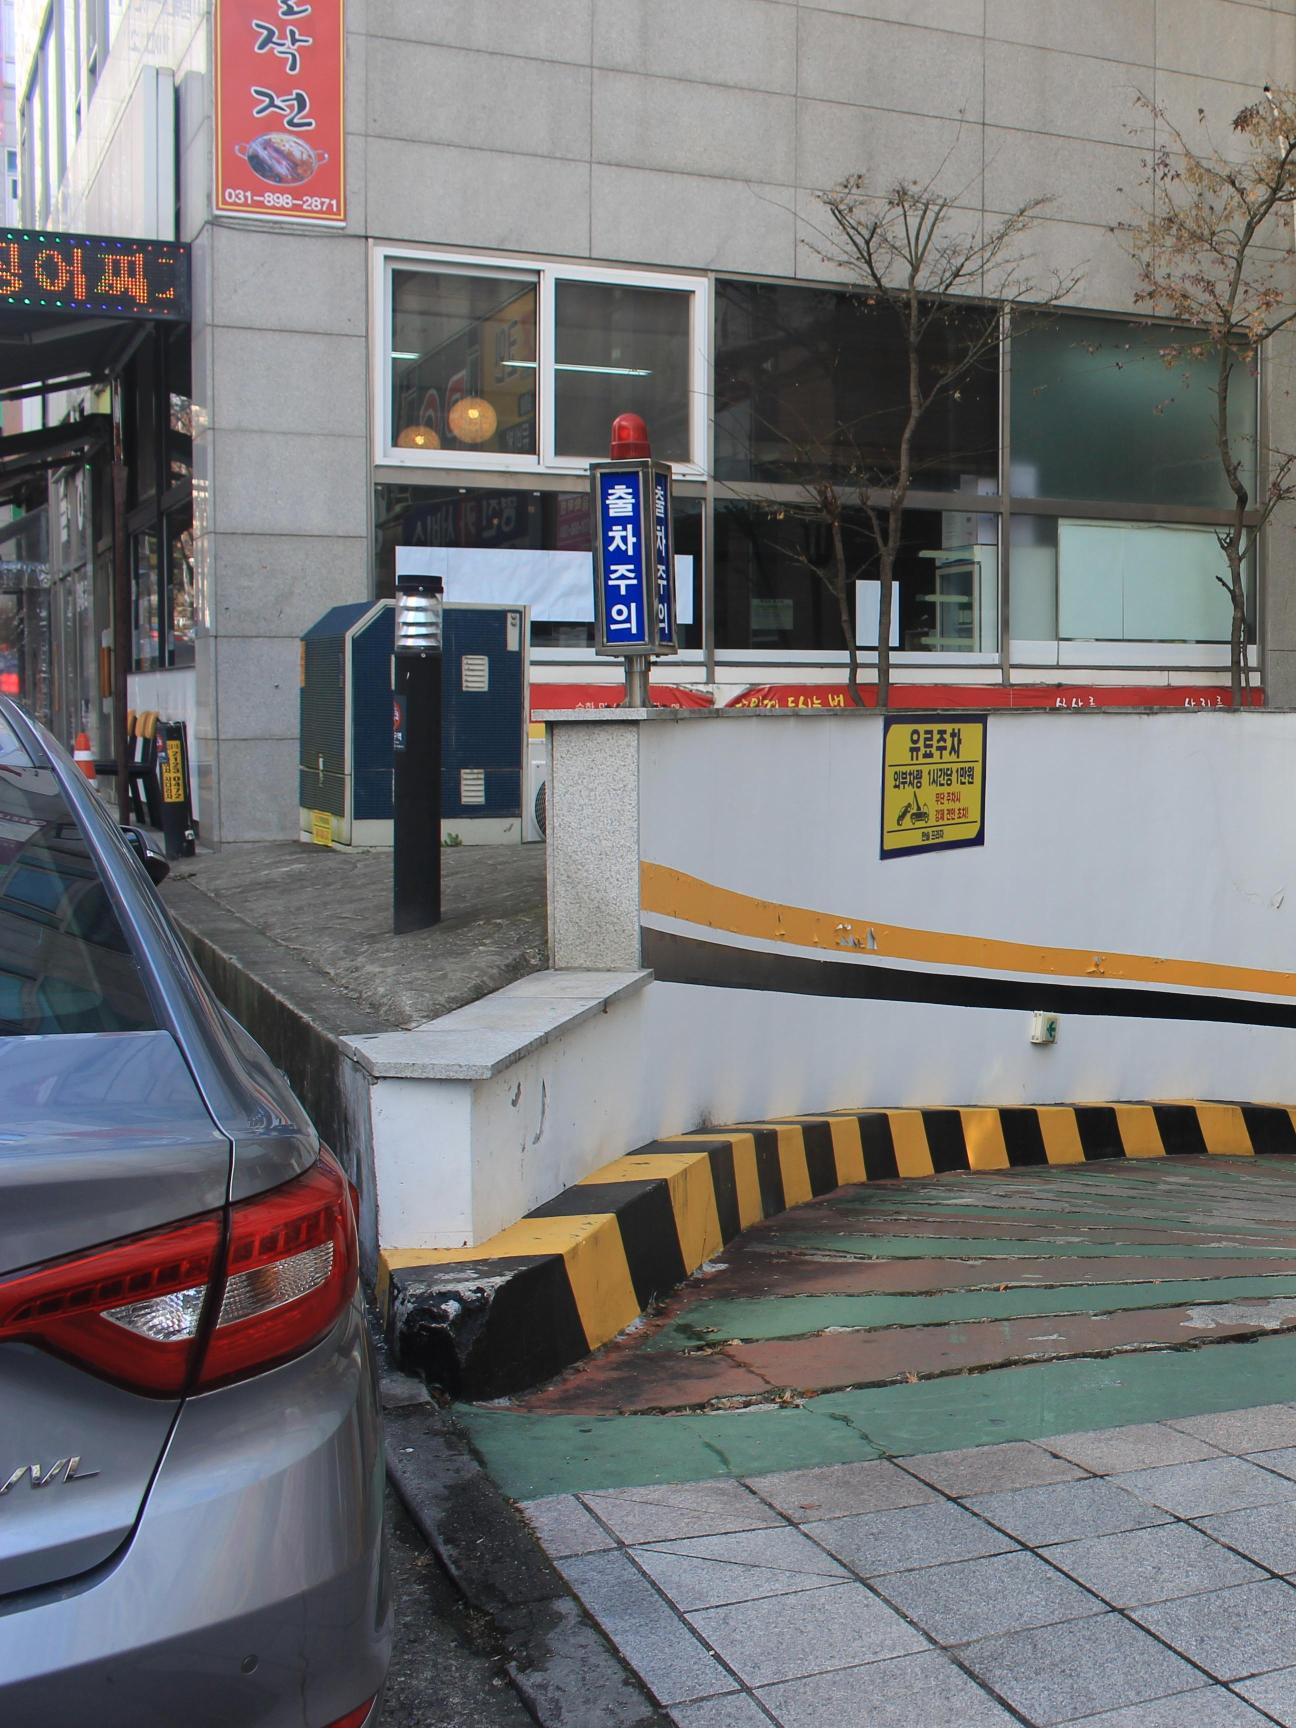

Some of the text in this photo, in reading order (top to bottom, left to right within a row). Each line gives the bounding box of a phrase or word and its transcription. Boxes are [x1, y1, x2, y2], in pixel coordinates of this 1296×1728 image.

[252, 0, 316, 130] 작전
[224, 187, 338, 212] 031-898-2871
[605, 484, 638, 635] 출차주의
[909, 728, 962, 761] 유료주차
[892, 766, 975, 790] 외부차량 1시간당 1만원
